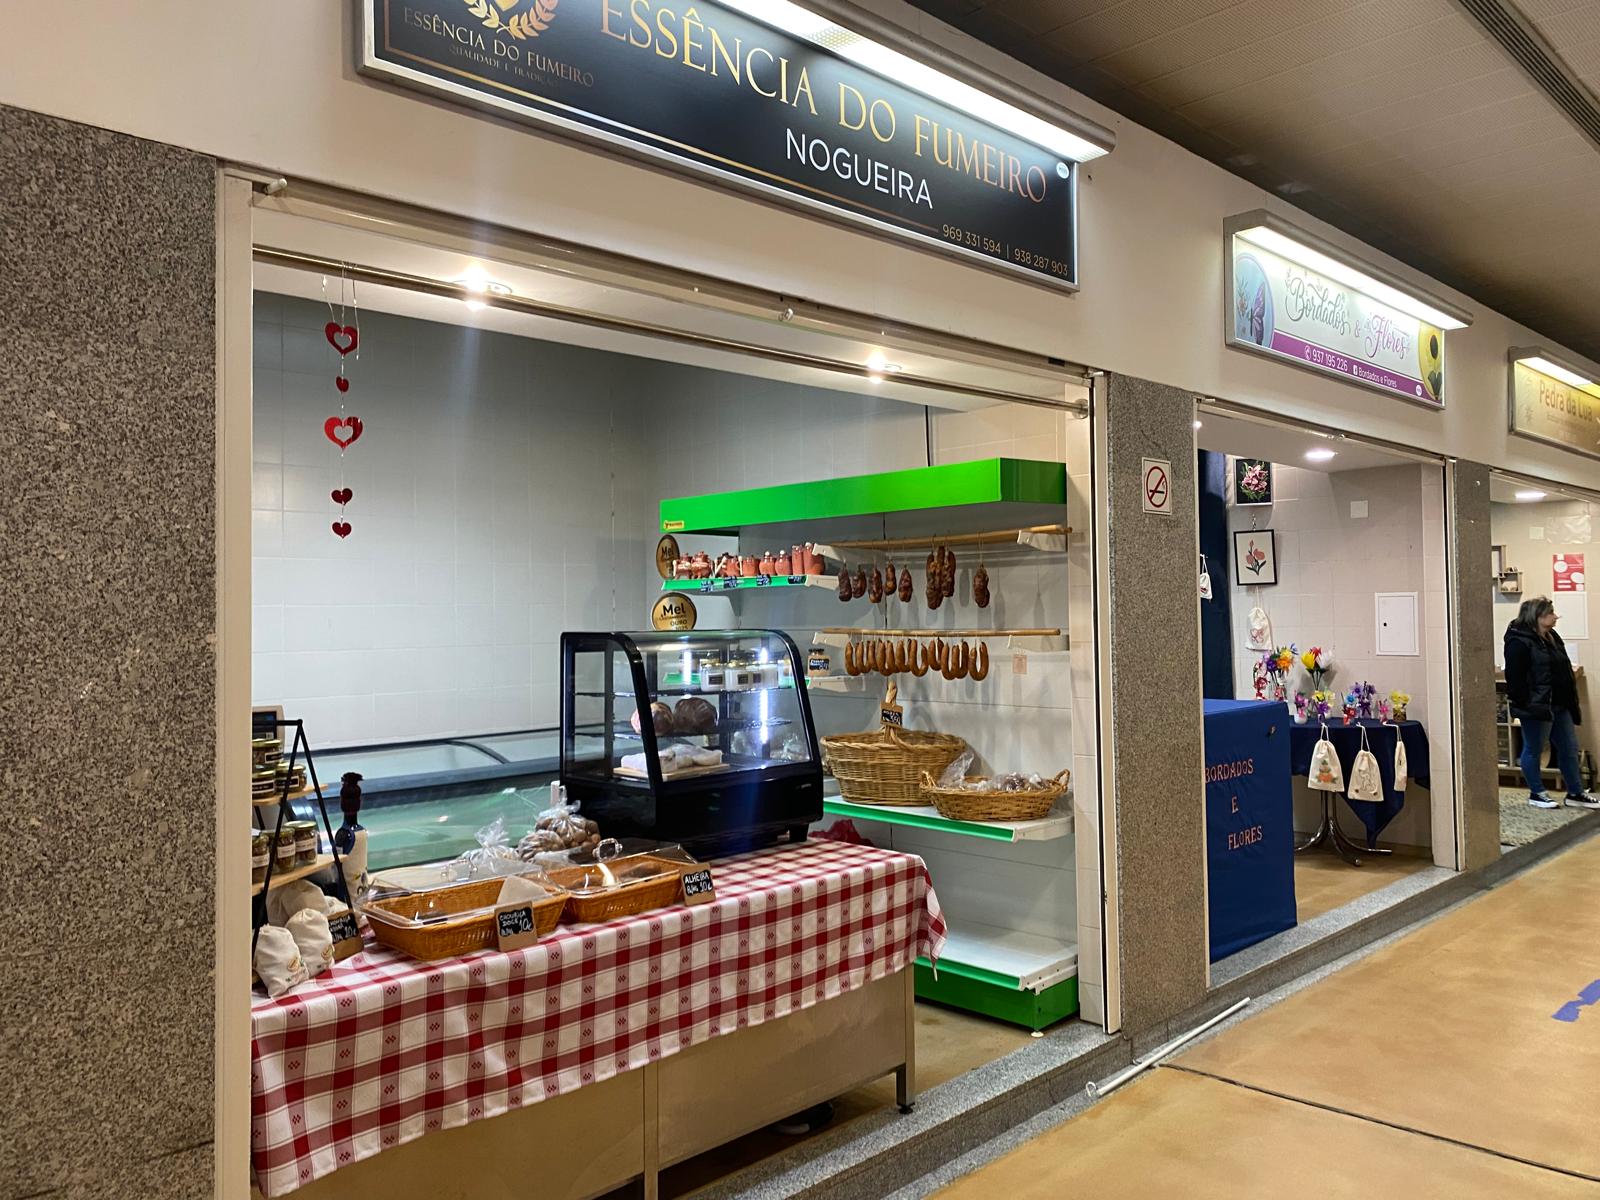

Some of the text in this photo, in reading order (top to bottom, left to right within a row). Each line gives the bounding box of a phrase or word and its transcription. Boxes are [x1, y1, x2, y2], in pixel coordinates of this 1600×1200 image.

[403, 7, 594, 88] ESSÊNCIA DO FUMEIRO
[600, 0, 1047, 204] ESSÊNCIA DO FUMEIRO
[785, 127, 934, 210] NOGUEIRA
[942, 223, 1068, 277] 969 331 594 938 287 903
[1284, 277, 1410, 360] Bordados & Flores
[1312, 348, 1325, 364] 937
[1325, 353, 1336, 369] 195
[1336, 356, 1348, 372] 226
[1358, 366, 1381, 384] Bordados
[1384, 376, 1398, 388] Flores
[1540, 379, 1592, 422] Pedra da Lua
[661, 545, 674, 557] Mel
[662, 602, 686, 616] Mel
[1205, 758, 1254, 784] BORDADOS
[1231, 795, 1239, 814] E
[1227, 825, 1263, 850] FLORES
